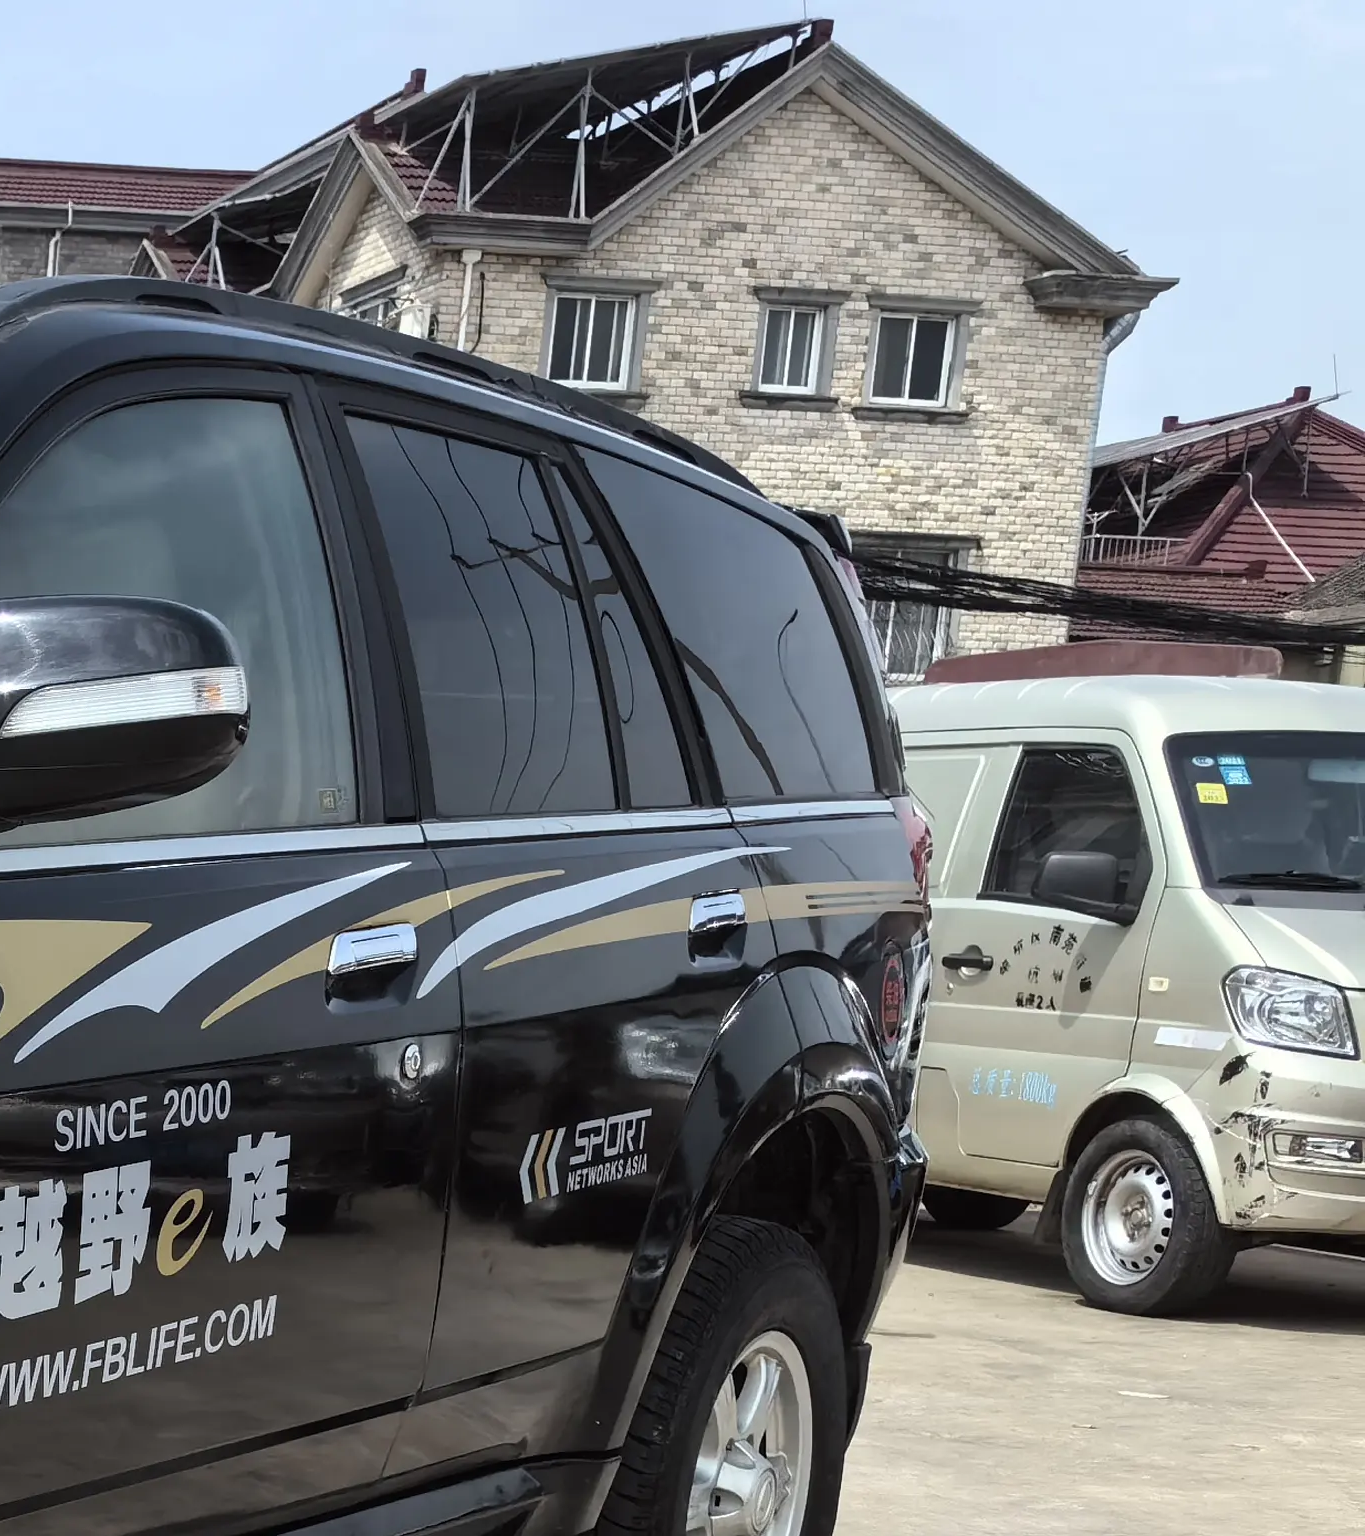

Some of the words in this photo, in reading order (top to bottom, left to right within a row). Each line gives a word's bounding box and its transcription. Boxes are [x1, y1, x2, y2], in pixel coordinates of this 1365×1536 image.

[54, 1096, 148, 1152] SINCE
[162, 1080, 231, 1133] 2000
[568, 1107, 653, 1167] SPORT
[566, 1159, 624, 1193] NETWORKS
[624, 1153, 648, 1178] ASIA
